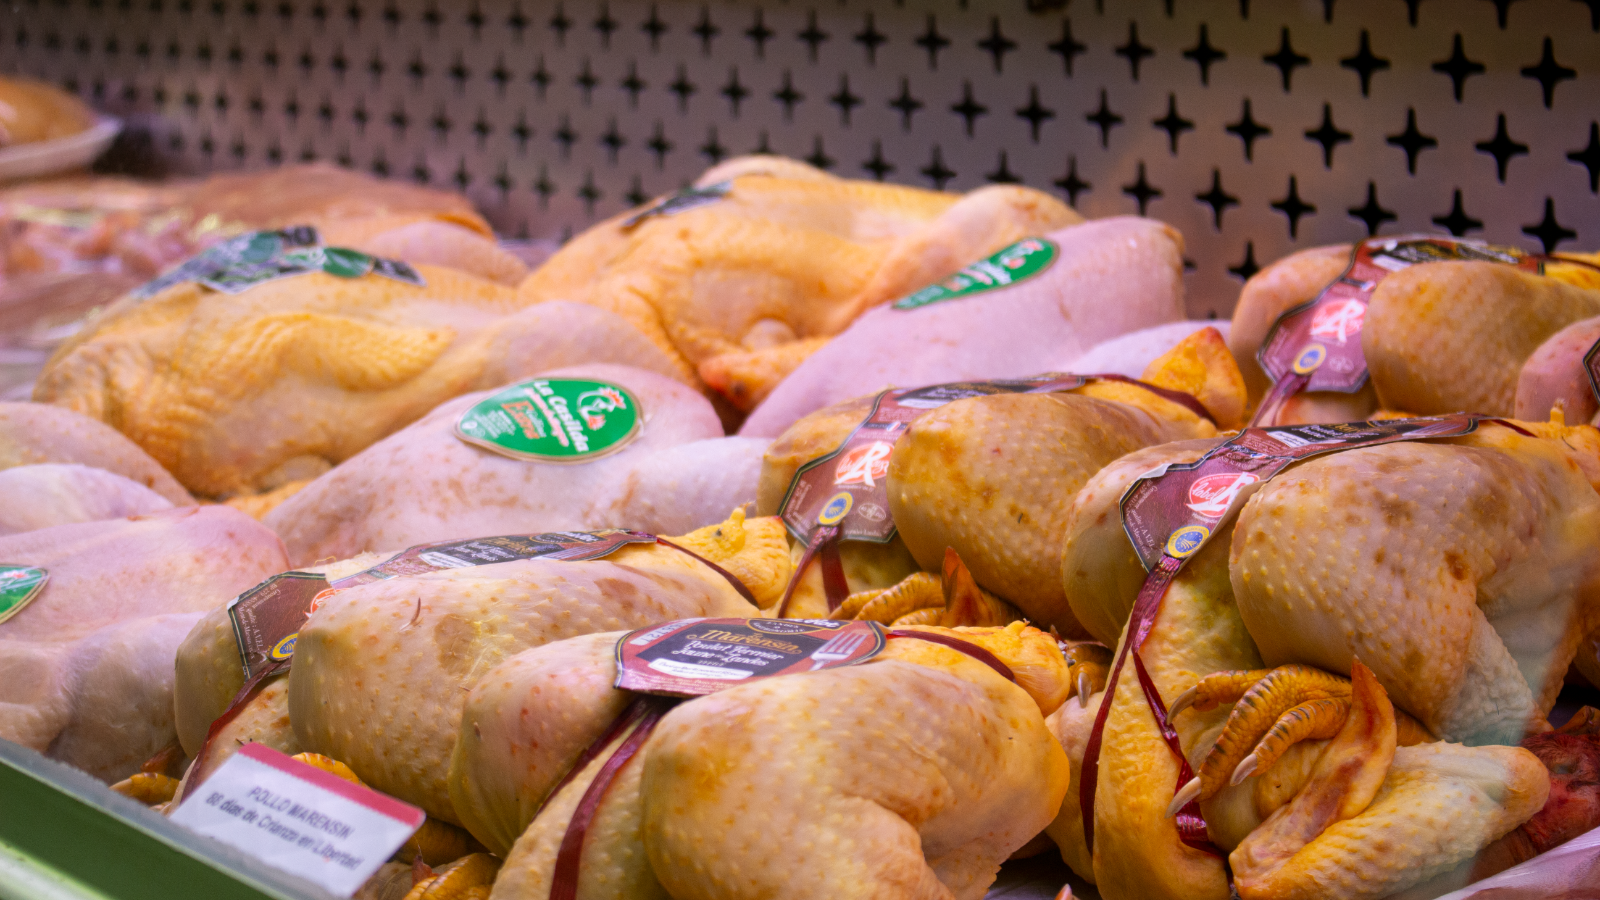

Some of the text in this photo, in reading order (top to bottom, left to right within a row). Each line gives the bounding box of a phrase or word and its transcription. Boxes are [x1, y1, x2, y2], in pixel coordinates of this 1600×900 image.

[533, 380, 554, 397] La
[548, 395, 589, 453] Casilda
[242, 809, 259, 824] de
[257, 814, 300, 843] Crianza
[298, 836, 315, 849] en
[248, 785, 355, 840] POLLO MARENSIN
